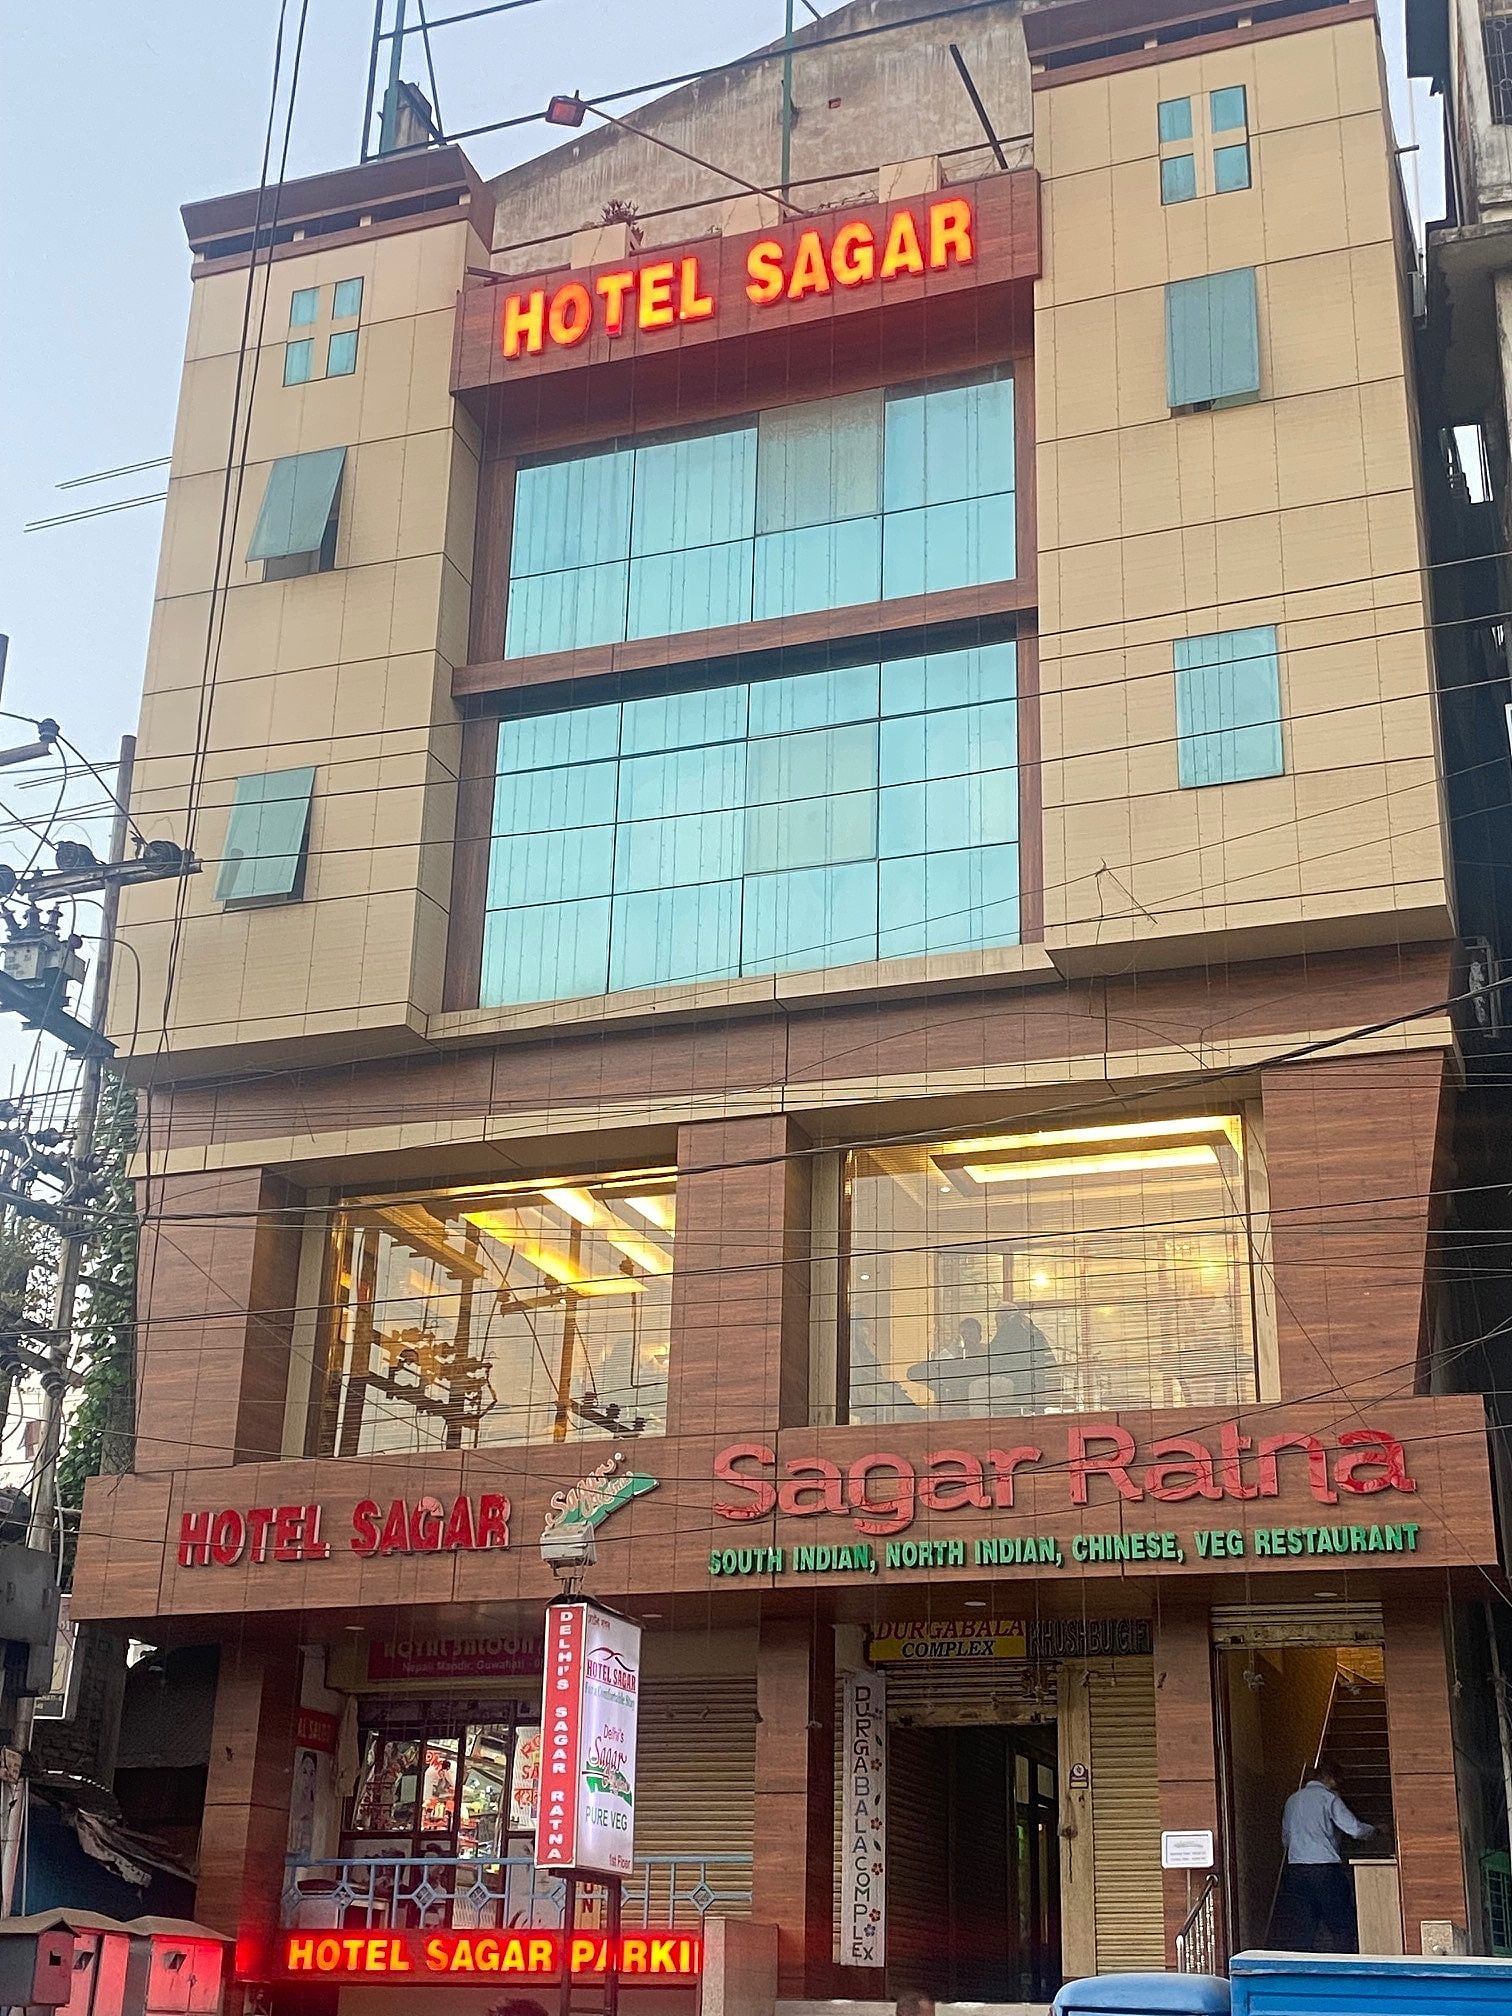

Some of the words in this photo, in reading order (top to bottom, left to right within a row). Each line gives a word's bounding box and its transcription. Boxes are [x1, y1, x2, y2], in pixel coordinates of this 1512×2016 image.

[502, 257, 714, 360] HOTEL
[745, 196, 975, 306] SAGAR
[714, 1442, 1042, 1536] Sagar
[1067, 1421, 1417, 1506] Ratna
[177, 1504, 331, 1568] HOTEL
[349, 1493, 512, 1557] SAGAR
[709, 1546, 783, 1575] SOUTH
[792, 1544, 878, 1576] INDIAN,
[885, 1539, 965, 1569] NORTH
[974, 1536, 1065, 1568] INDIAN,
[1071, 1531, 1185, 1565] CHINESE,
[1193, 1528, 1246, 1558] VEG
[1254, 1523, 1421, 1556] RESTAURANT
[555, 1611, 573, 1690] DELHI'S
[876, 1619, 1025, 1640] DURGABALA
[901, 1640, 997, 1658] COMPLEX
[587, 1658, 611, 1683] HOTEL
[613, 1669, 636, 1691] SAGAR
[552, 1706, 568, 1774] SAGAR
[603, 1724, 624, 1743] Delhi's
[547, 1790, 564, 1859] RATNA
[586, 1806, 608, 1828] PURE
[610, 1812, 628, 1831] VEG
[609, 1854, 617, 1867] 1st
[852, 1856, 875, 1961] COMPLEX
[287, 1937, 410, 1972] HOTEL
[425, 1937, 553, 1973] SAGAR
